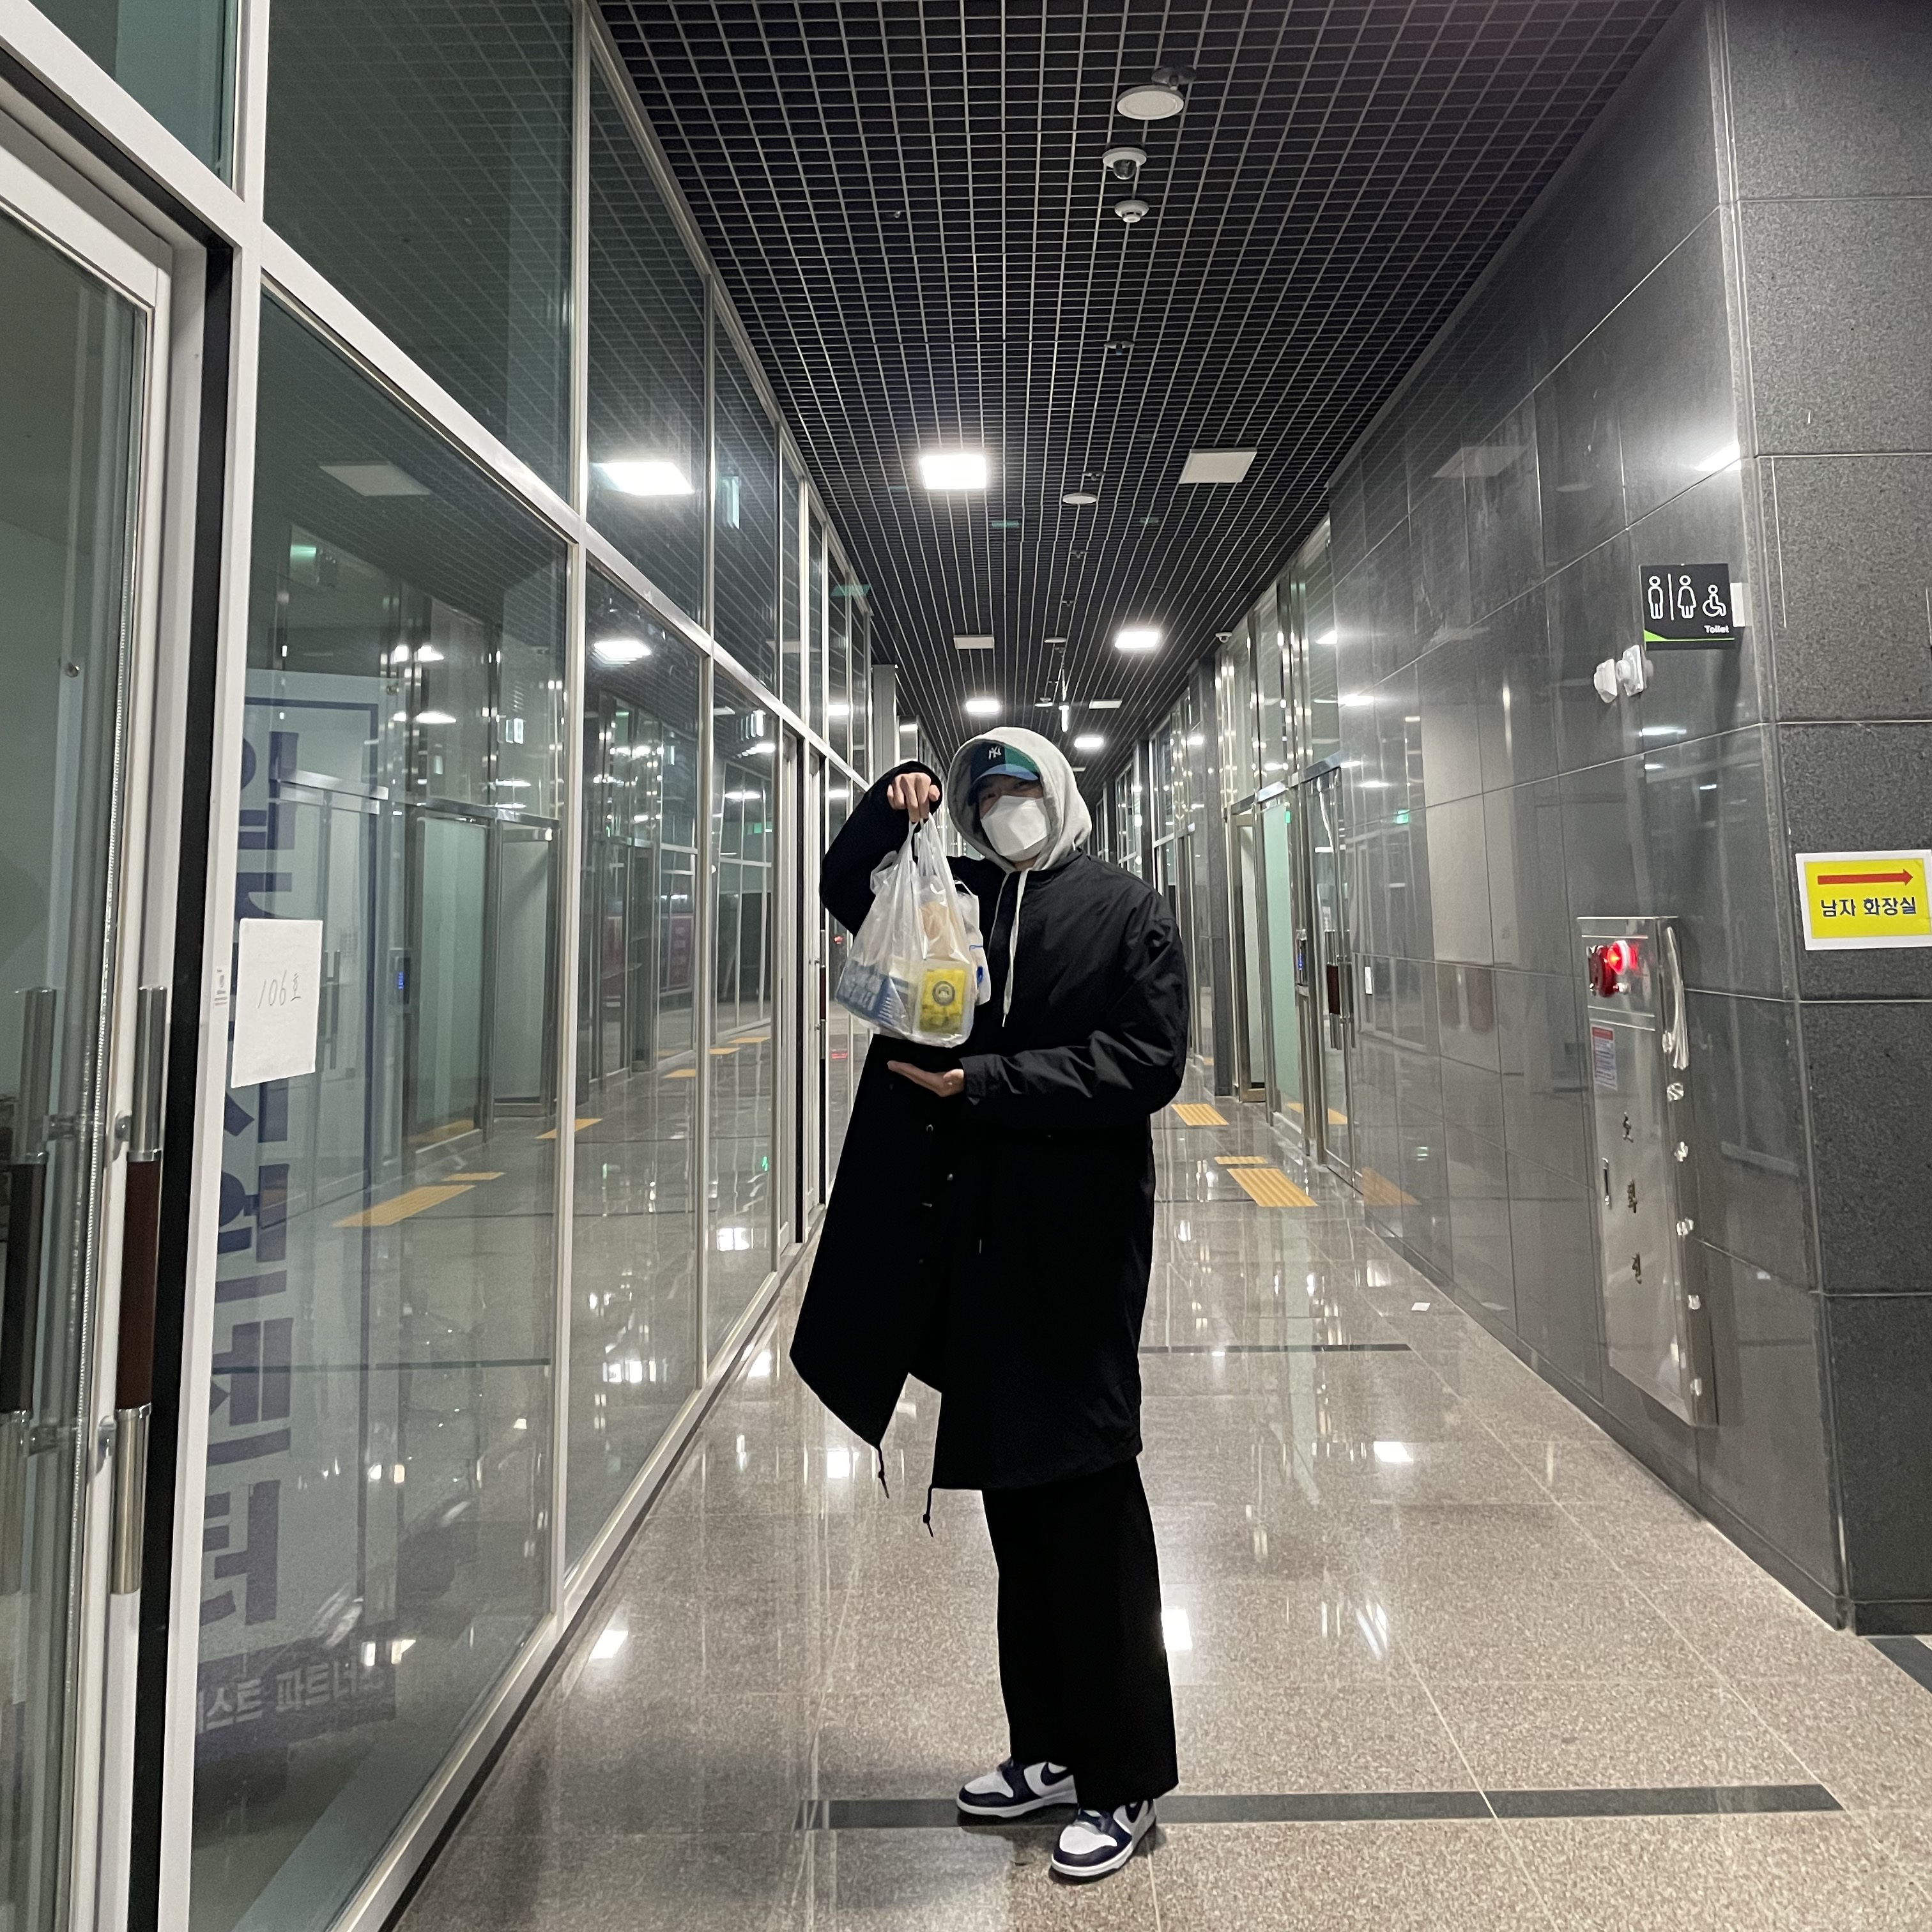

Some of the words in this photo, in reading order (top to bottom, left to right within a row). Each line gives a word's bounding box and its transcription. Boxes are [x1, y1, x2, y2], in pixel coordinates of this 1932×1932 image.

[1703, 625, 1729, 634] Toilet
[1820, 899, 1856, 917] 남자
[1863, 897, 1917, 916] 화장실
[198, 1679, 263, 1733] 스트
